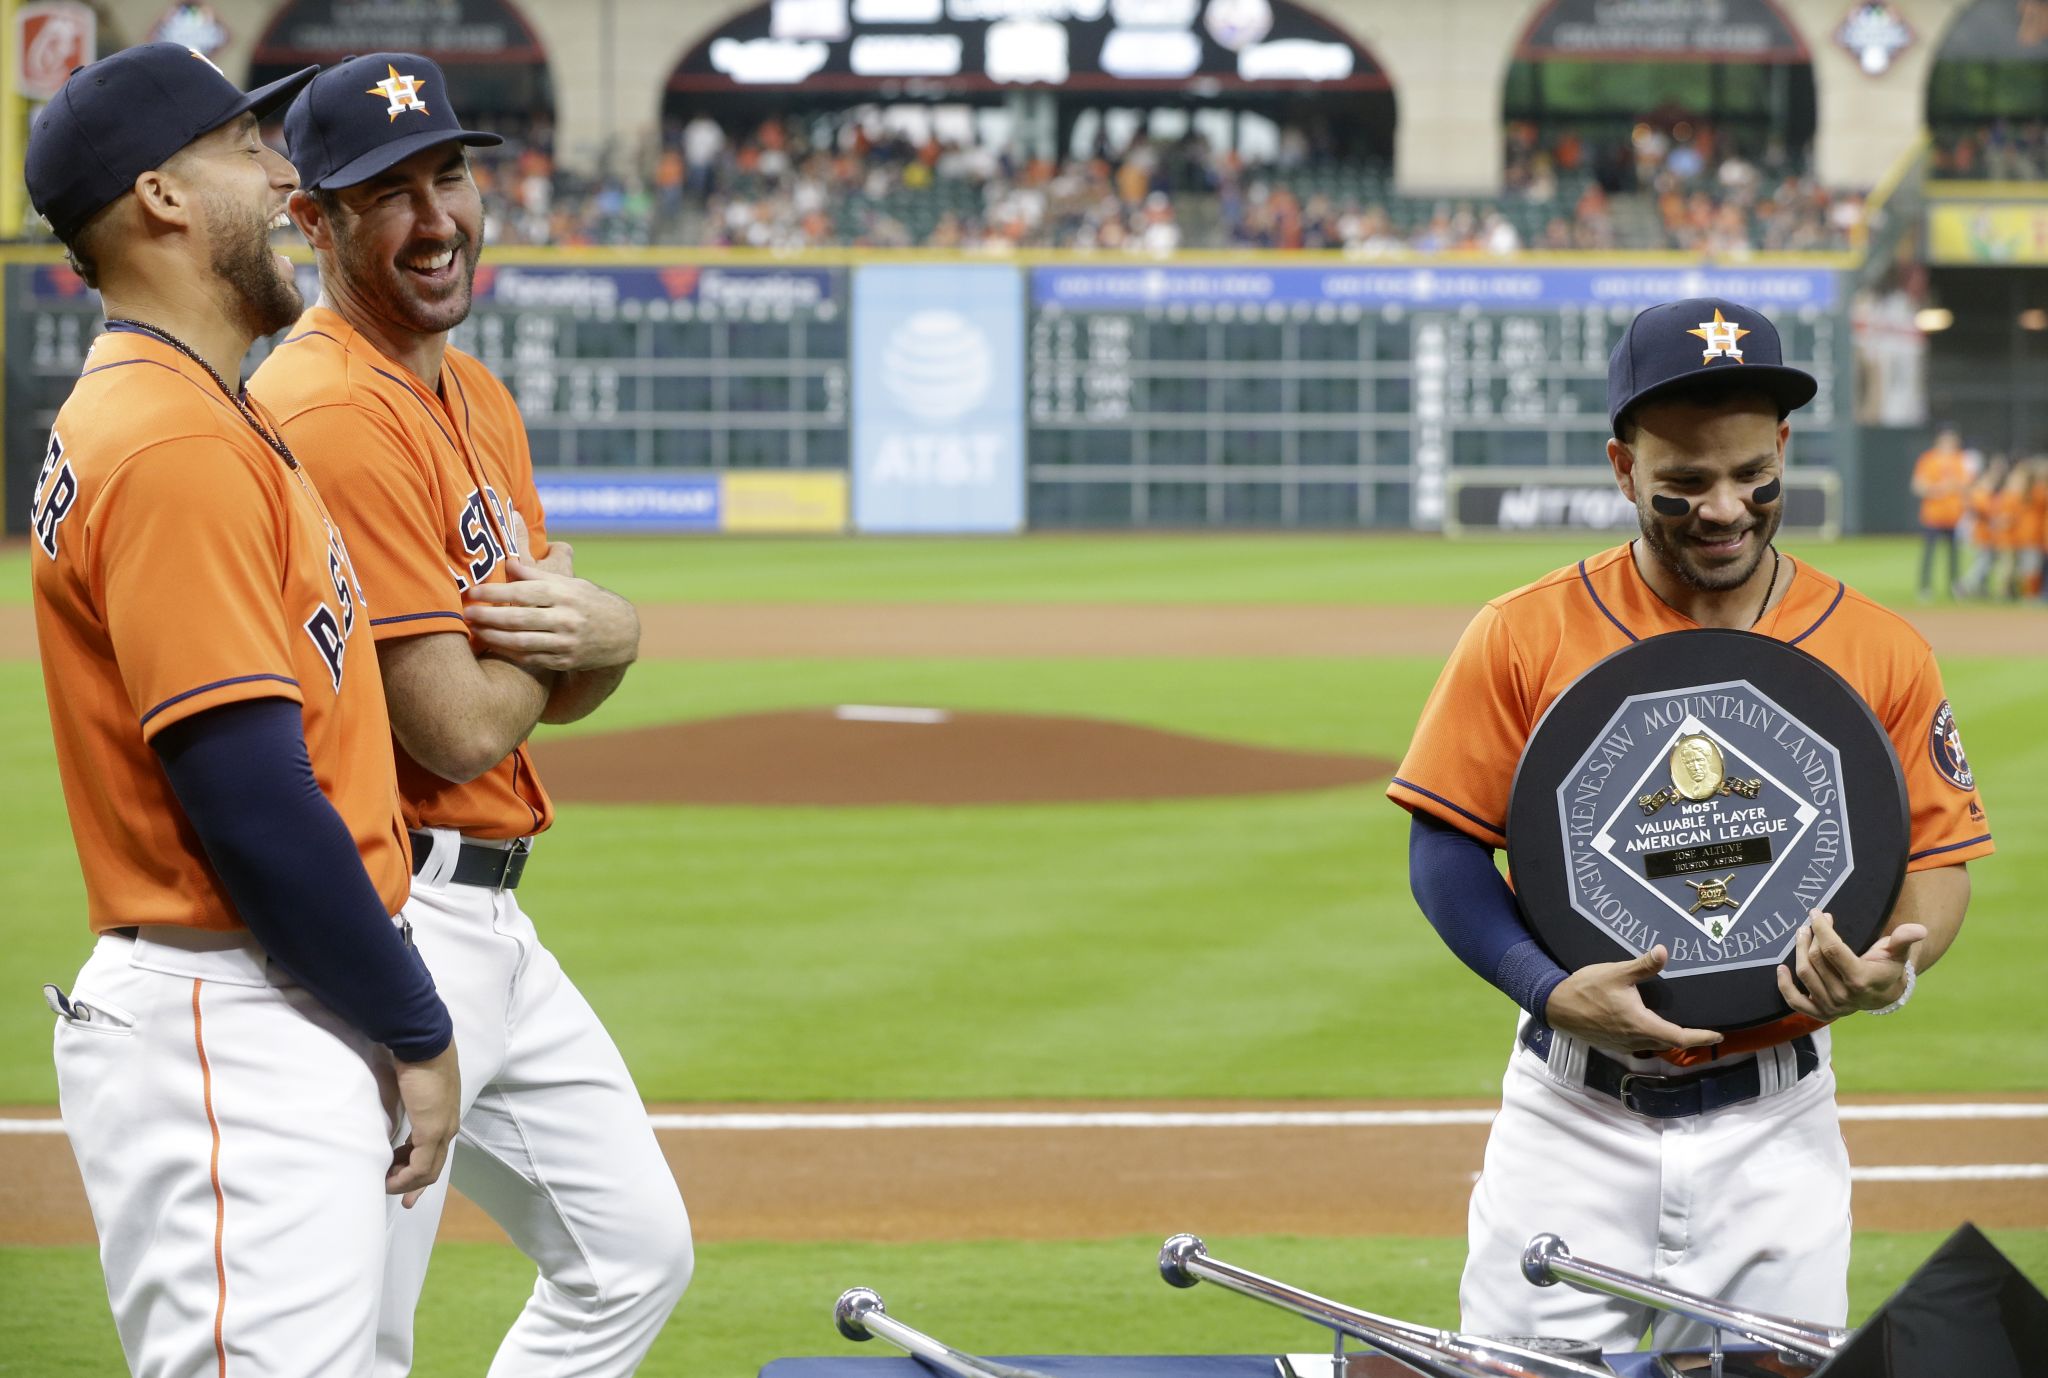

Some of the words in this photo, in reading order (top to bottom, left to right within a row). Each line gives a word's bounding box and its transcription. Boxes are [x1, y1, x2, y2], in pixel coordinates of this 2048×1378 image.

[31, 428, 78, 560] ER
[447, 485, 520, 593] STR
[1571, 724, 1635, 837] KENESAW
[1643, 695, 1777, 736] MOUNTAIN
[1772, 720, 1837, 807] LANDIS
[1635, 816, 1706, 836] VALUABLE
[1714, 807, 1767, 825] PLAYER
[1682, 801, 1719, 815] MOST
[1625, 829, 1711, 853] AMERICAN
[1720, 818, 1788, 840] LEAGUE
[1672, 848, 1697, 861] JOSE
[1702, 842, 1743, 857] ALTUVE
[1675, 859, 1709, 872] HOUSTON
[1713, 854, 1743, 866] ASTROS
[1573, 850, 1660, 952] MEMORIAL
[1670, 911, 1797, 962] BASEBALL
[1793, 819, 1839, 912] AWARD
[1700, 888, 1723, 899] 2017
